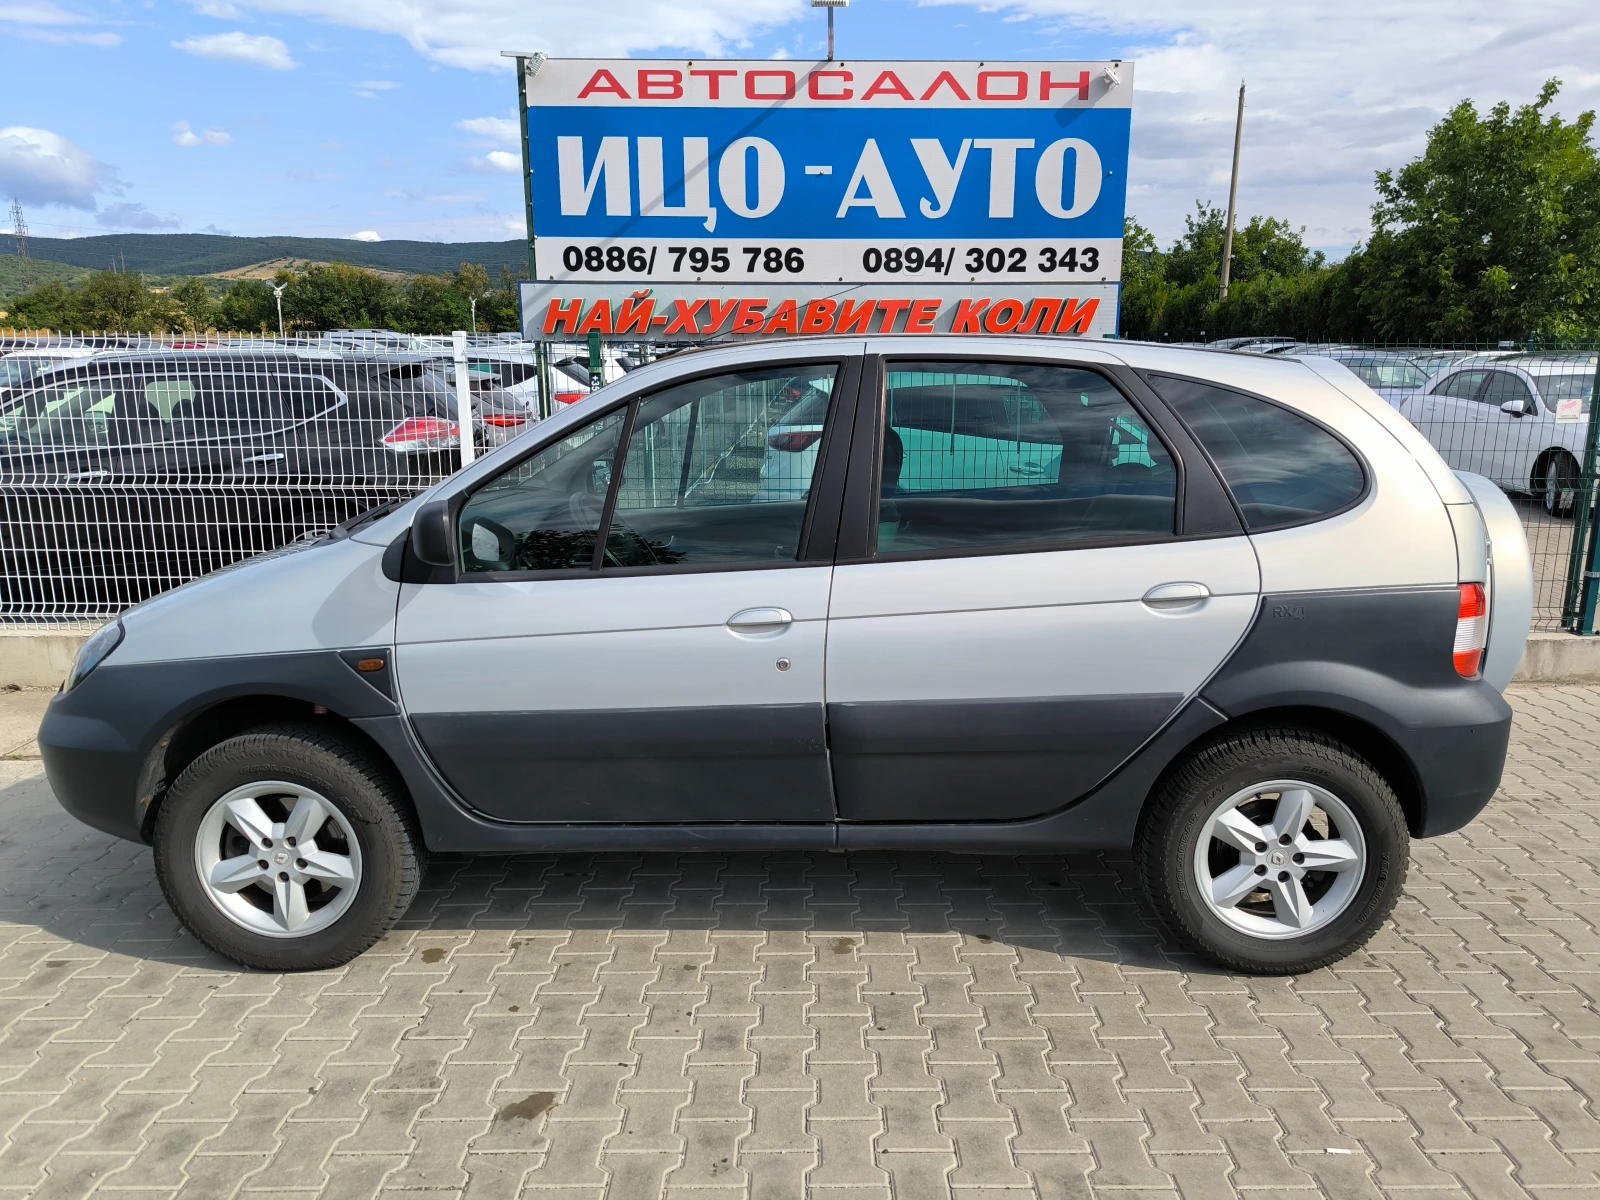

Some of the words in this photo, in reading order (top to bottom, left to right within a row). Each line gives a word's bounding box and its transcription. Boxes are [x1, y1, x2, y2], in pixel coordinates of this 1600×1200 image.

[577, 69, 1090, 100] АВТОСАЛОН
[563, 246, 657, 275] 0886/
[668, 246, 731, 274] 795
[743, 246, 805, 274] 786
[863, 246, 956, 276] 0894/
[965, 247, 1027, 274] 302
[1038, 247, 1100, 274] 343
[542, 288, 942, 335] НАЙ-ХУБАВИТЕ
[956, 298, 1101, 334] КОЛИ
[1272, 604, 1305, 620] RX4
